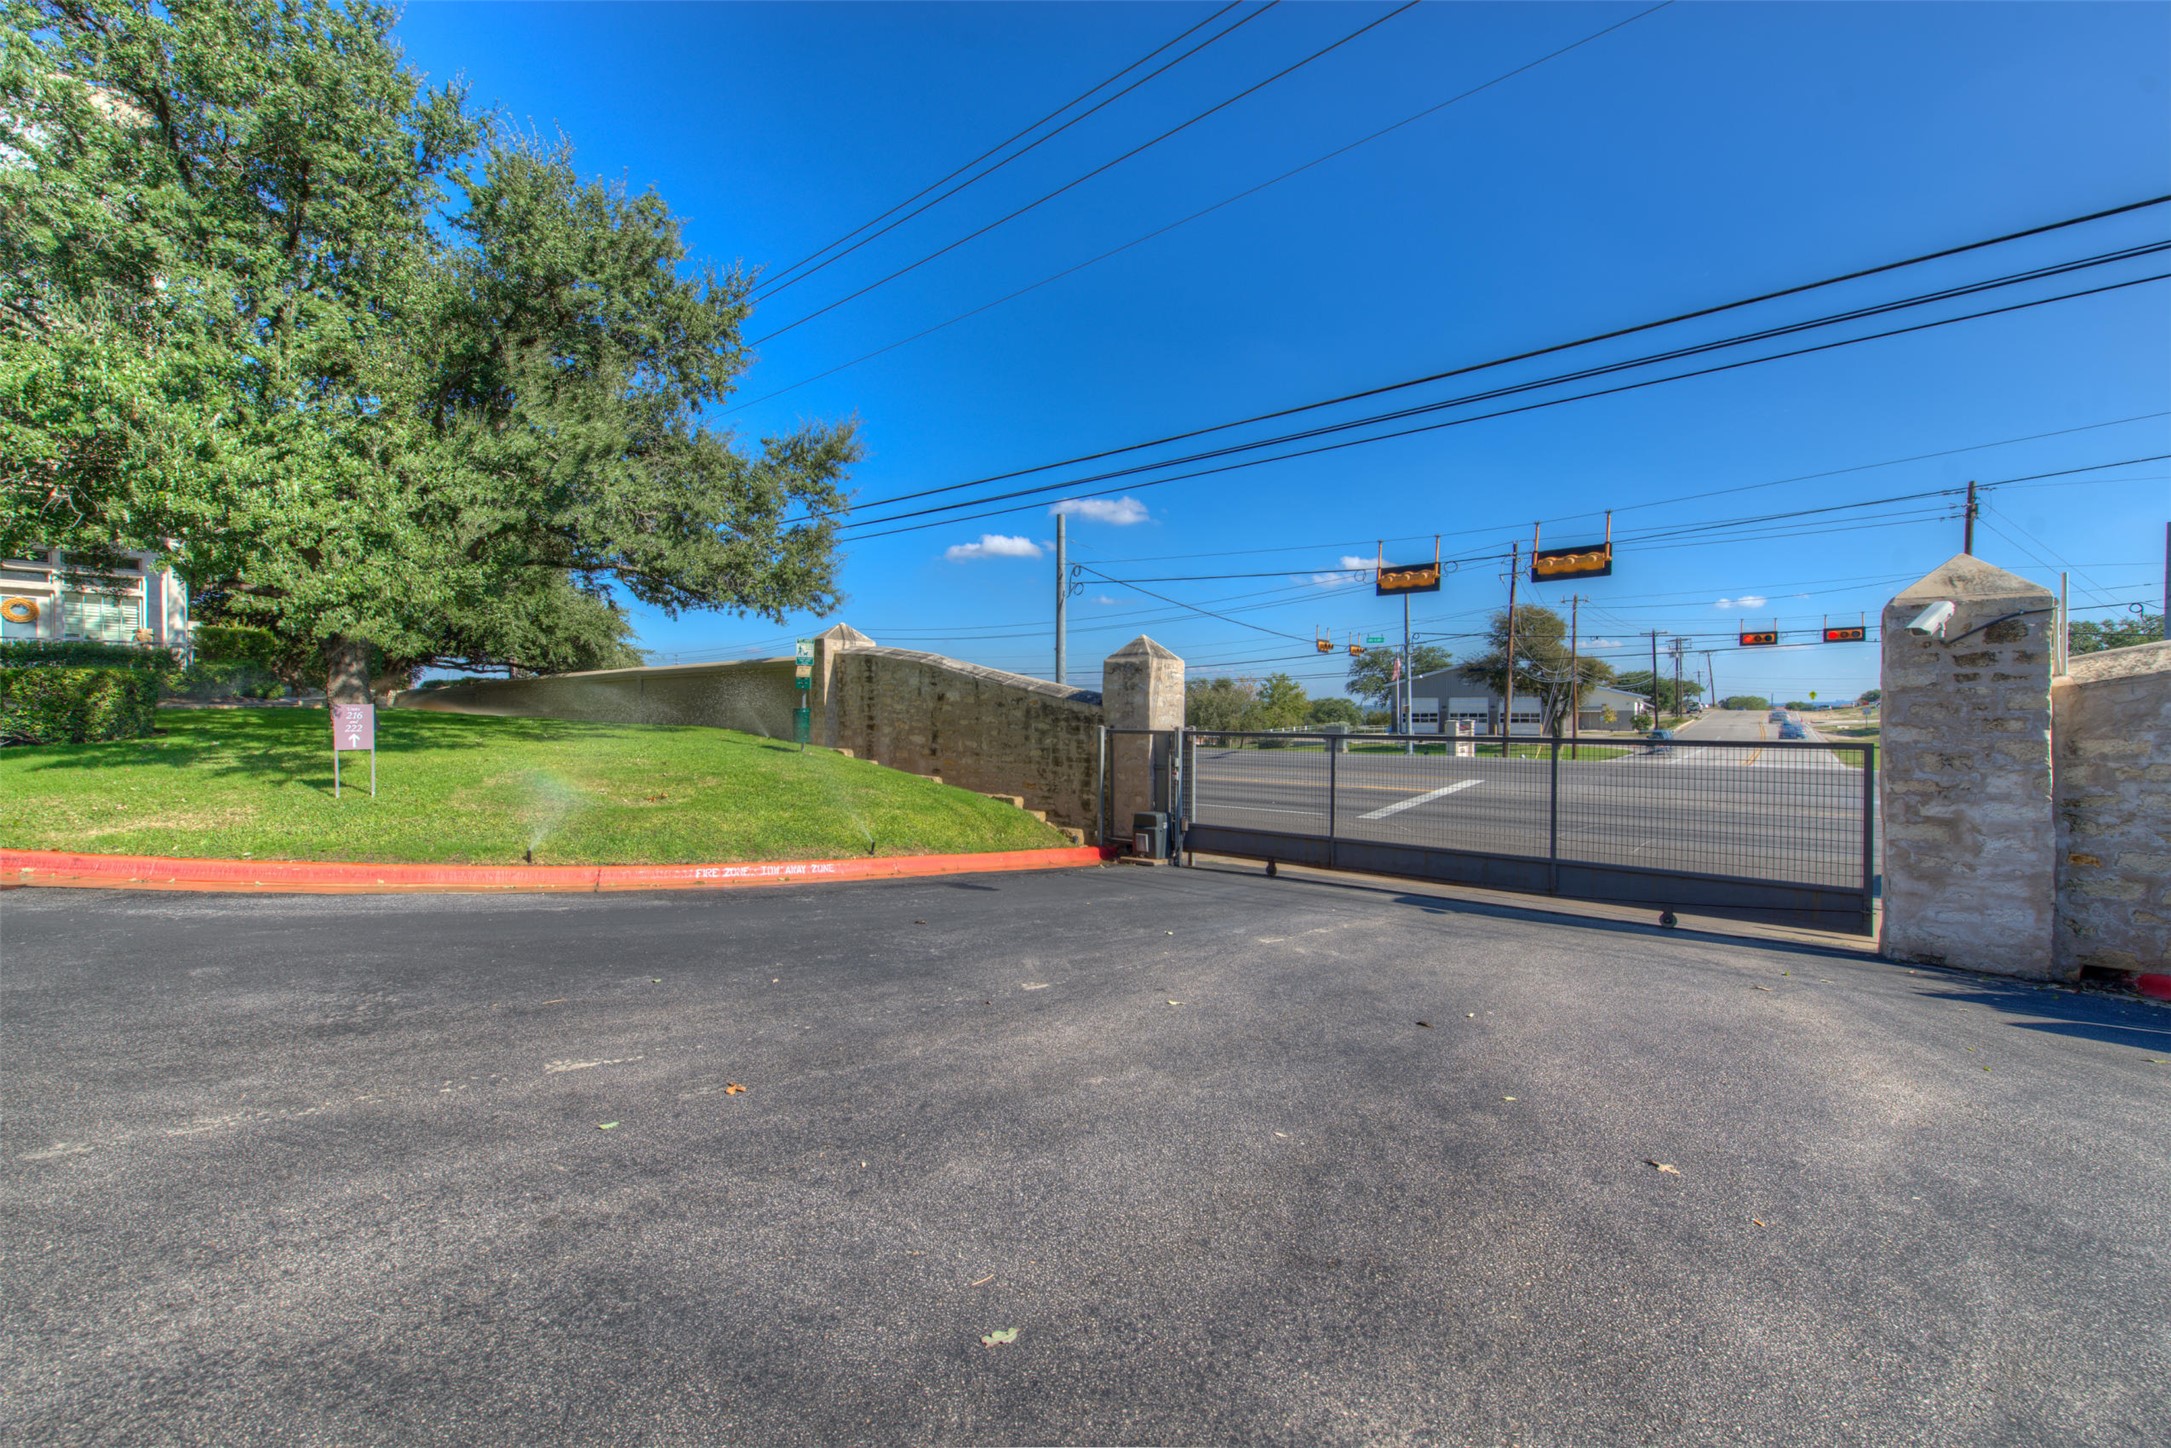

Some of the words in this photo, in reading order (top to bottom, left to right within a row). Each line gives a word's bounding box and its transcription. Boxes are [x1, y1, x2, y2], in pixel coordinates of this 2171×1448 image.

[346, 711, 363, 720] 216
[344, 724, 363, 732] 222
[695, 867, 720, 879] FIRE
[722, 866, 750, 878] ZONE
[785, 864, 806, 875] AWAY
[811, 863, 835, 874] ZONE
